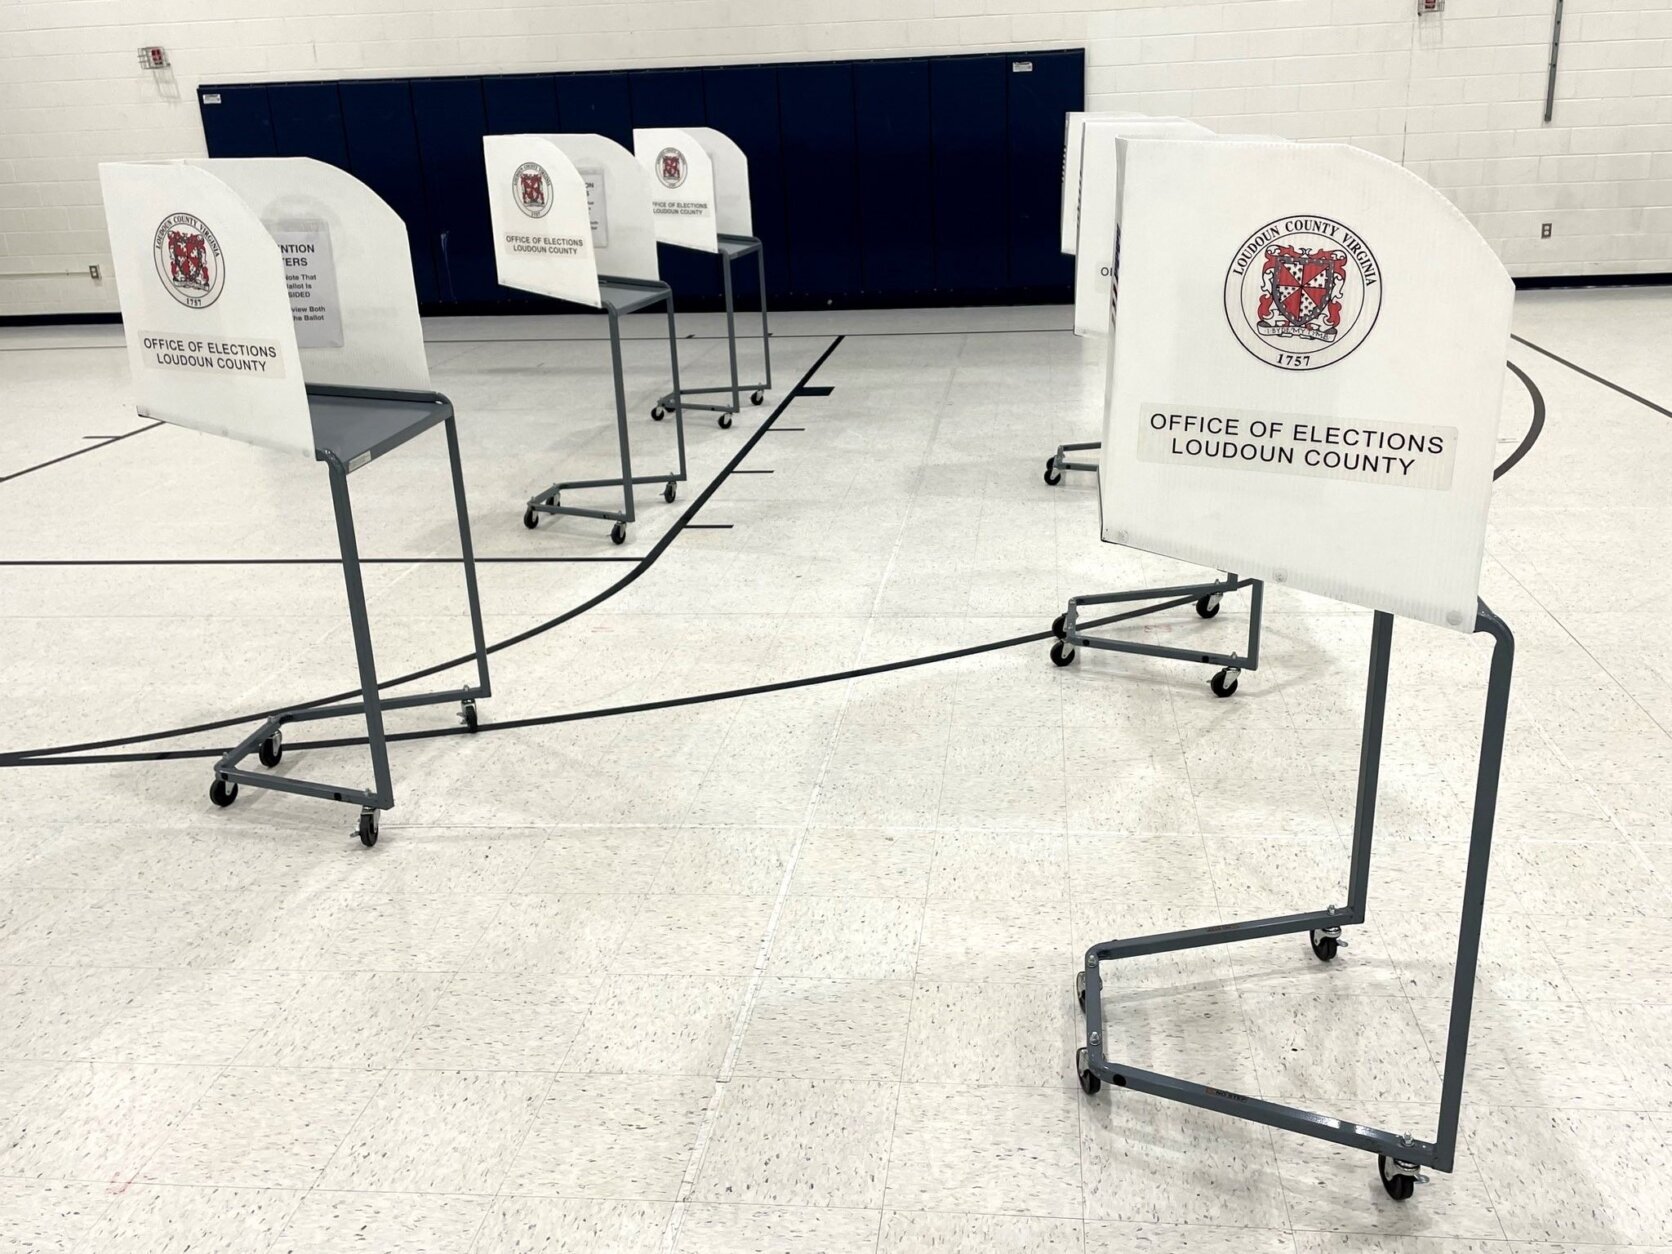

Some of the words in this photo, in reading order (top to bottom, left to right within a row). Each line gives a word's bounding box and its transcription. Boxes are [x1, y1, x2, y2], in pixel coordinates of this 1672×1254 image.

[173, 215, 198, 227] COUNTY
[199, 223, 220, 258] VIRGINIA
[505, 235, 531, 244] OFFICE
[532, 236, 542, 245] OF
[543, 237, 583, 247] ELECTIONS
[278, 244, 315, 254] NTION
[513, 244, 547, 253] LOUDOUN
[548, 246, 578, 255] COUNTY
[1233, 225, 1280, 276] LOUDOUN
[1285, 219, 1340, 237] COUNTY
[1342, 233, 1377, 287] VIRGINIA
[282, 257, 308, 267] ERS
[143, 337, 185, 352] OFFICE
[188, 341, 203, 353] OF
[207, 342, 277, 358] ELECTIONS
[156, 353, 213, 368] LOUDOUN
[217, 358, 266, 372] COUNTY
[1277, 353, 1311, 367] 1757
[1150, 412, 1240, 436] OFFICE
[1249, 420, 1284, 439] OF
[1293, 424, 1444, 454] ELECTIONS
[1171, 437, 1294, 464] LOUDOUN
[1304, 449, 1415, 476] COUNTY
